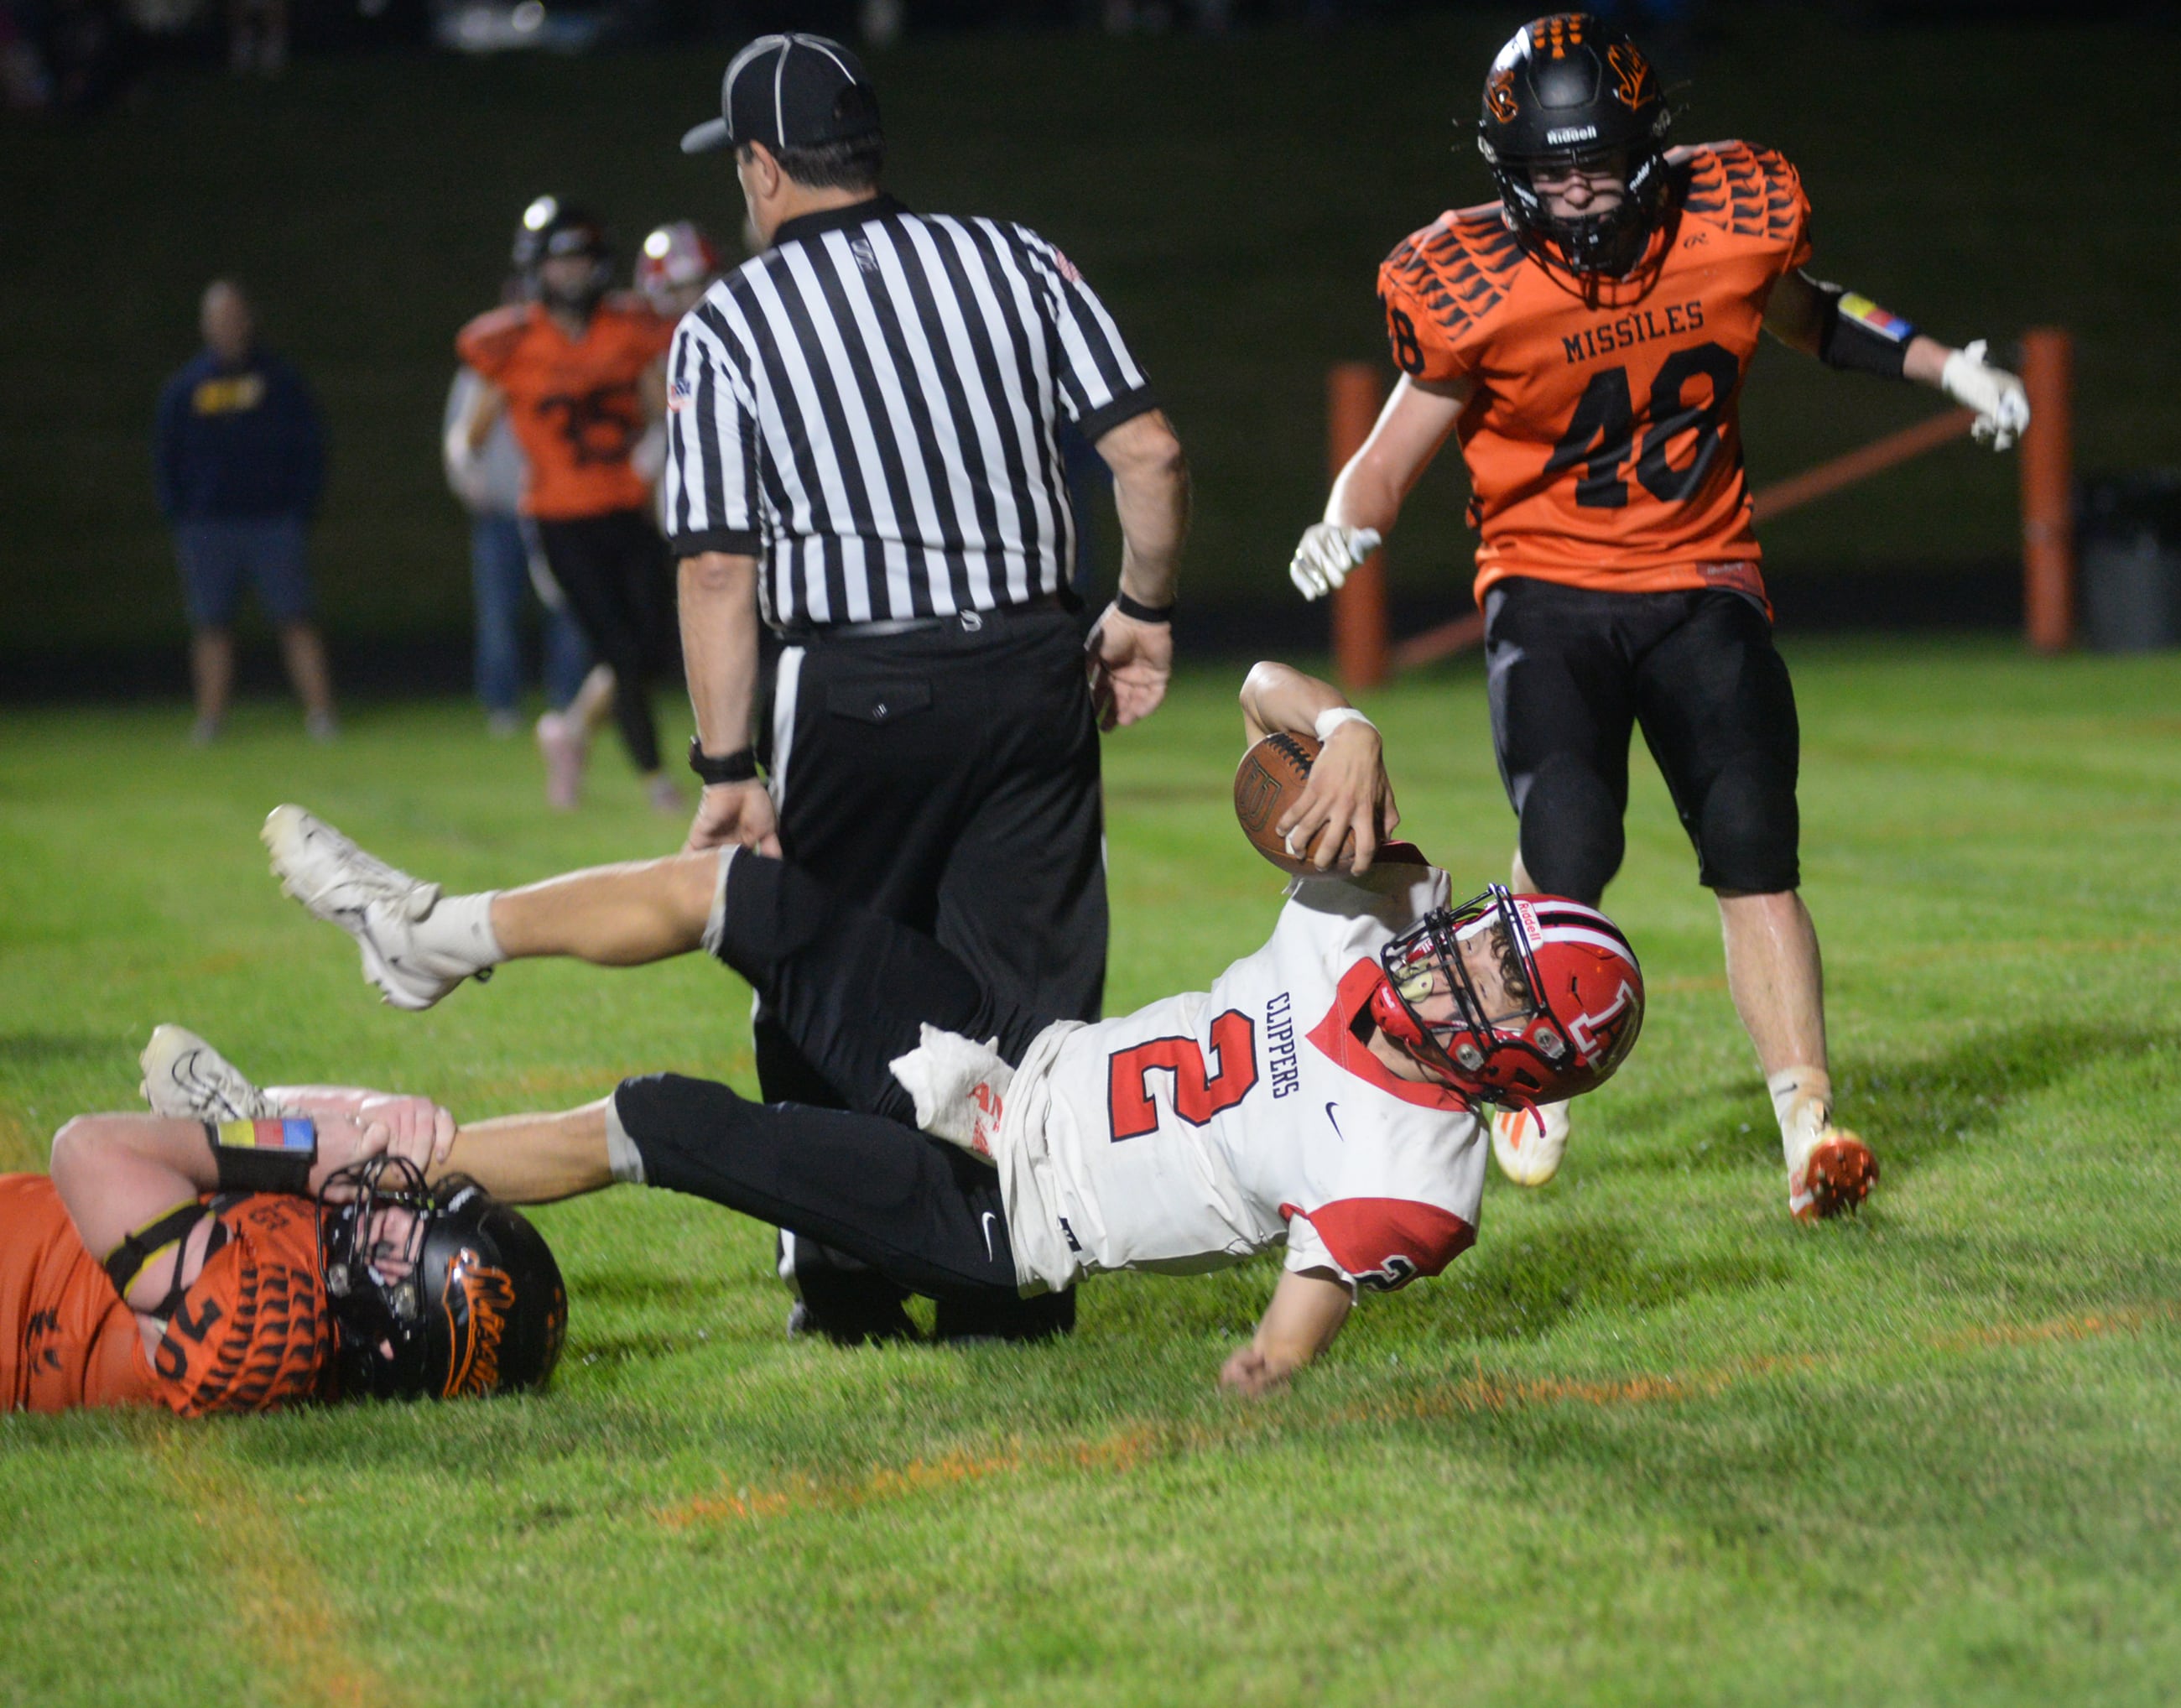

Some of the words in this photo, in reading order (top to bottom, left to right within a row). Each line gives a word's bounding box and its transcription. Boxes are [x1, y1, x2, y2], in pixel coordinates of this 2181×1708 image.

[1561, 299, 1705, 364] MISSILES
[1543, 341, 1741, 508] 48
[1517, 902, 1542, 942] Riddell
[1107, 1008, 1259, 1143] 2
[1266, 992, 1299, 1100] CLIPPERS
